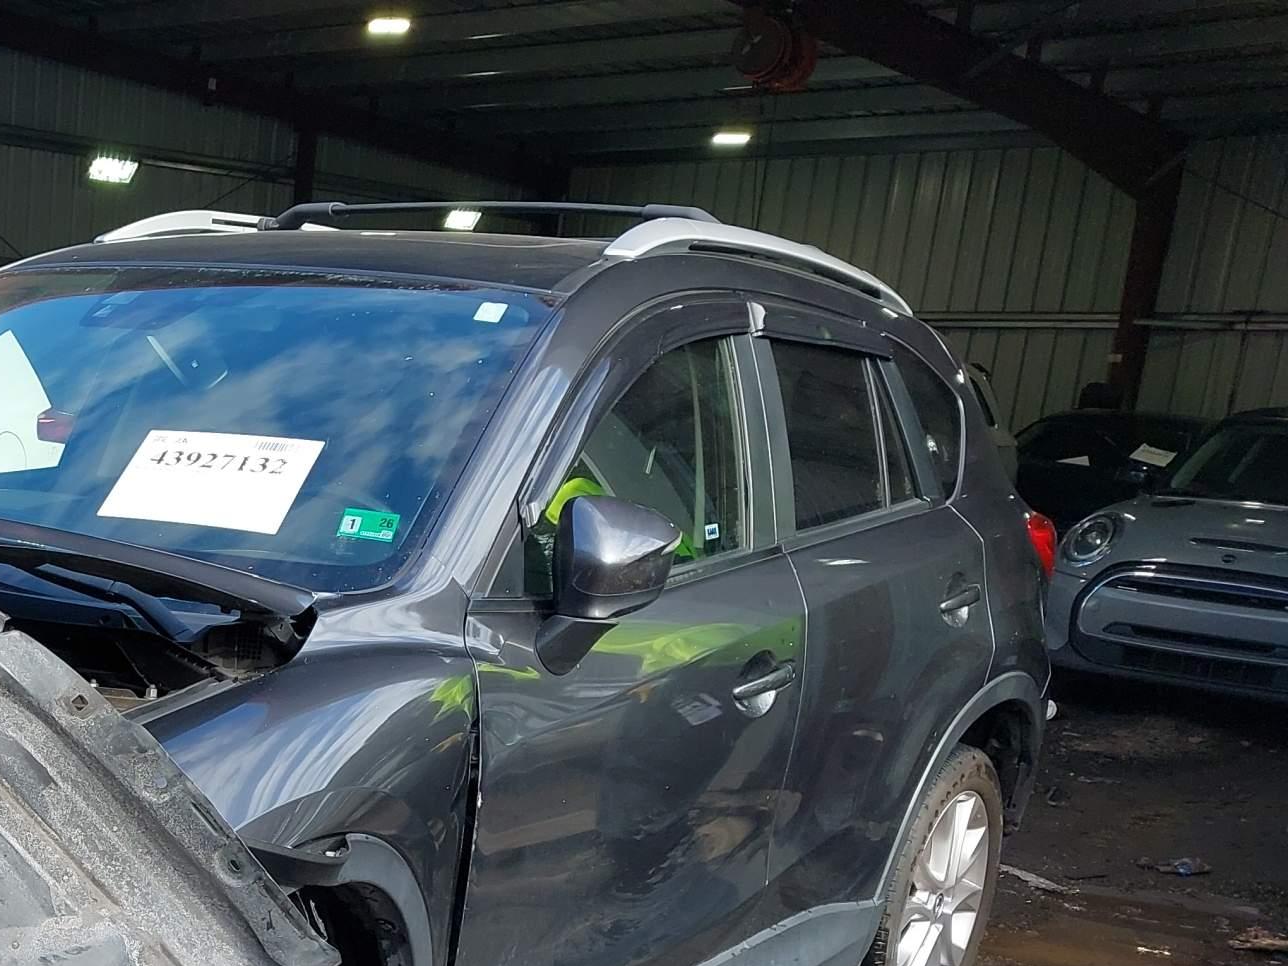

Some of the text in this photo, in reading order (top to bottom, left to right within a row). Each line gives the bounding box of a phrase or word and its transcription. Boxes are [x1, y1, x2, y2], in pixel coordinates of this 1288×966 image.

[150, 449, 288, 475] 43927132
[349, 517, 394, 530] 1 26
